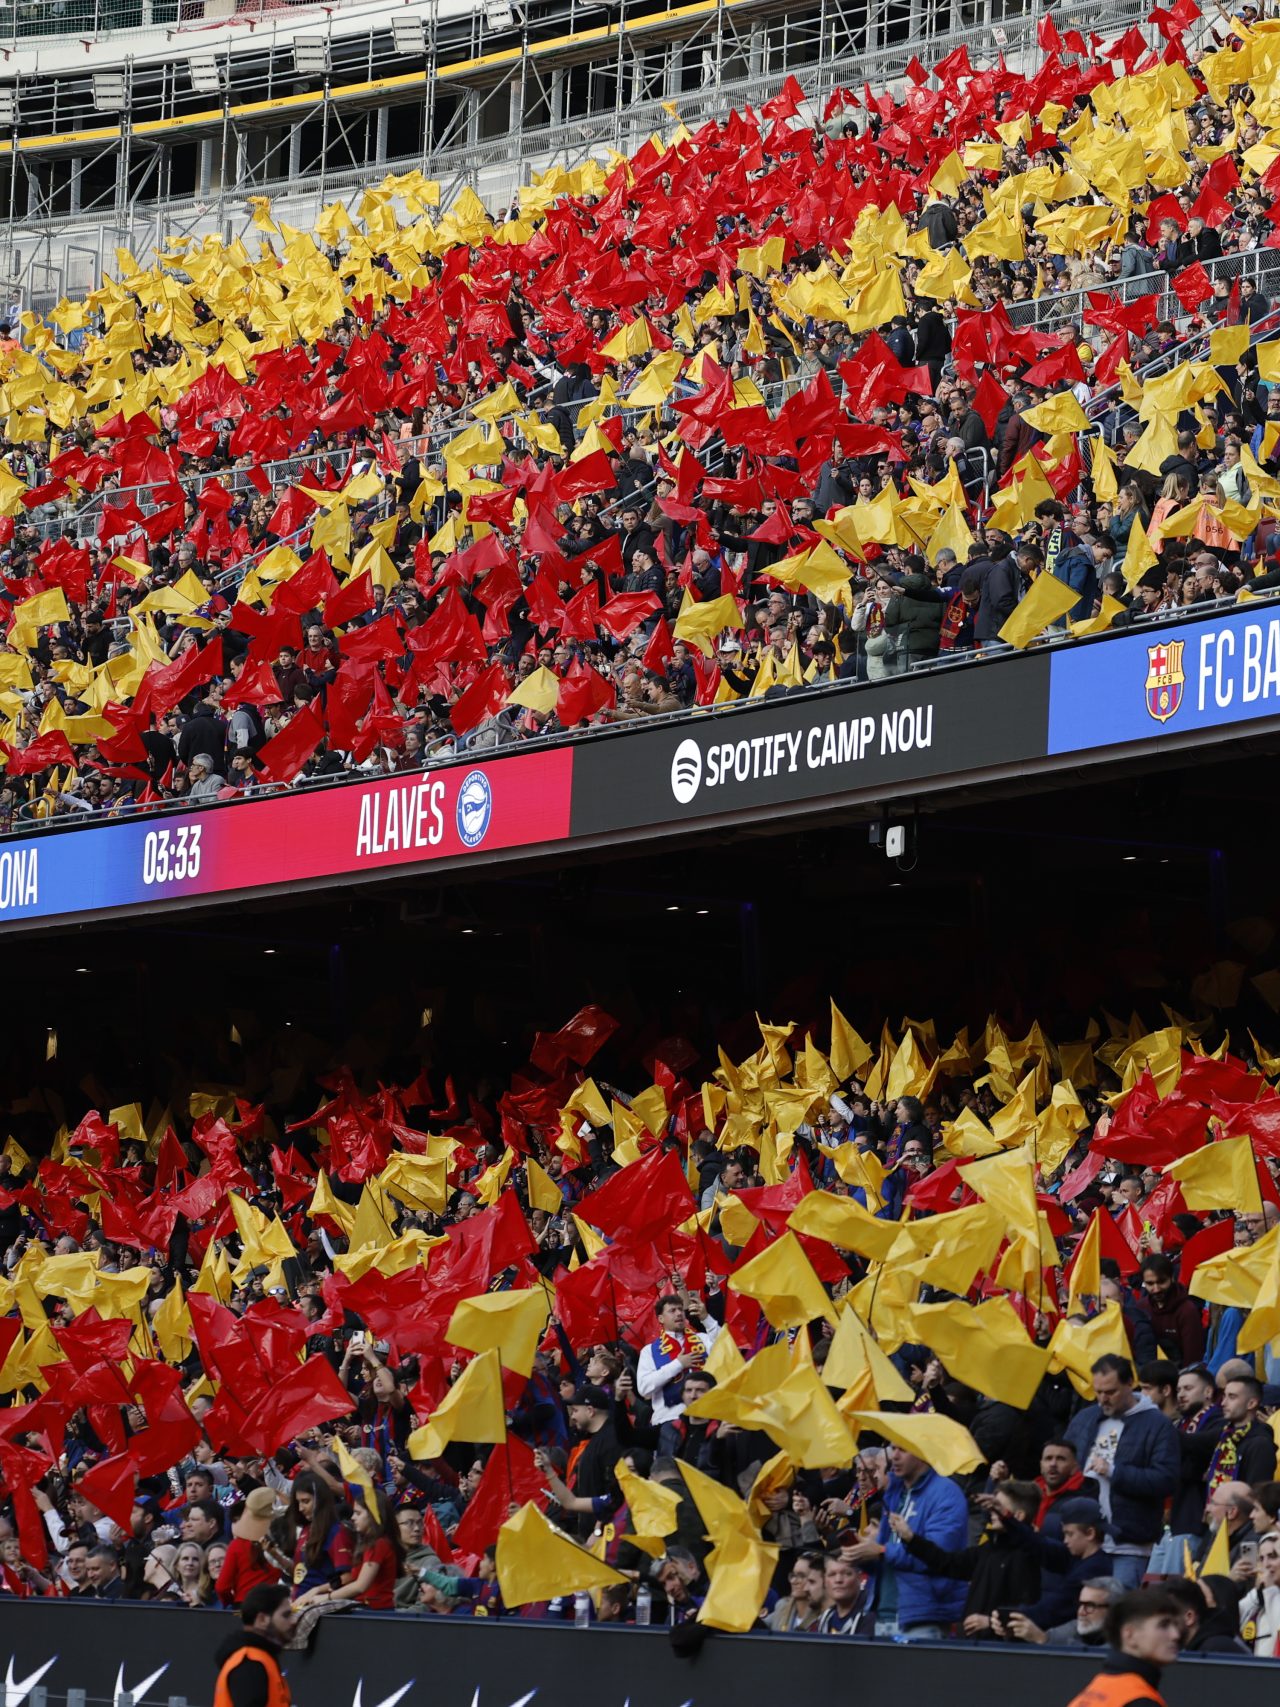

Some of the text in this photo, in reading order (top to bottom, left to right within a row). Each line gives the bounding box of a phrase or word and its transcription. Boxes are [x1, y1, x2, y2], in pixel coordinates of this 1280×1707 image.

[1157, 674, 1173, 686] FCB
[1198, 629, 1235, 711] FC
[705, 704, 933, 787] SPOTIFY CAMP NOU
[142, 824, 202, 885] 03:33
[356, 771, 445, 857] ALAVÉS
